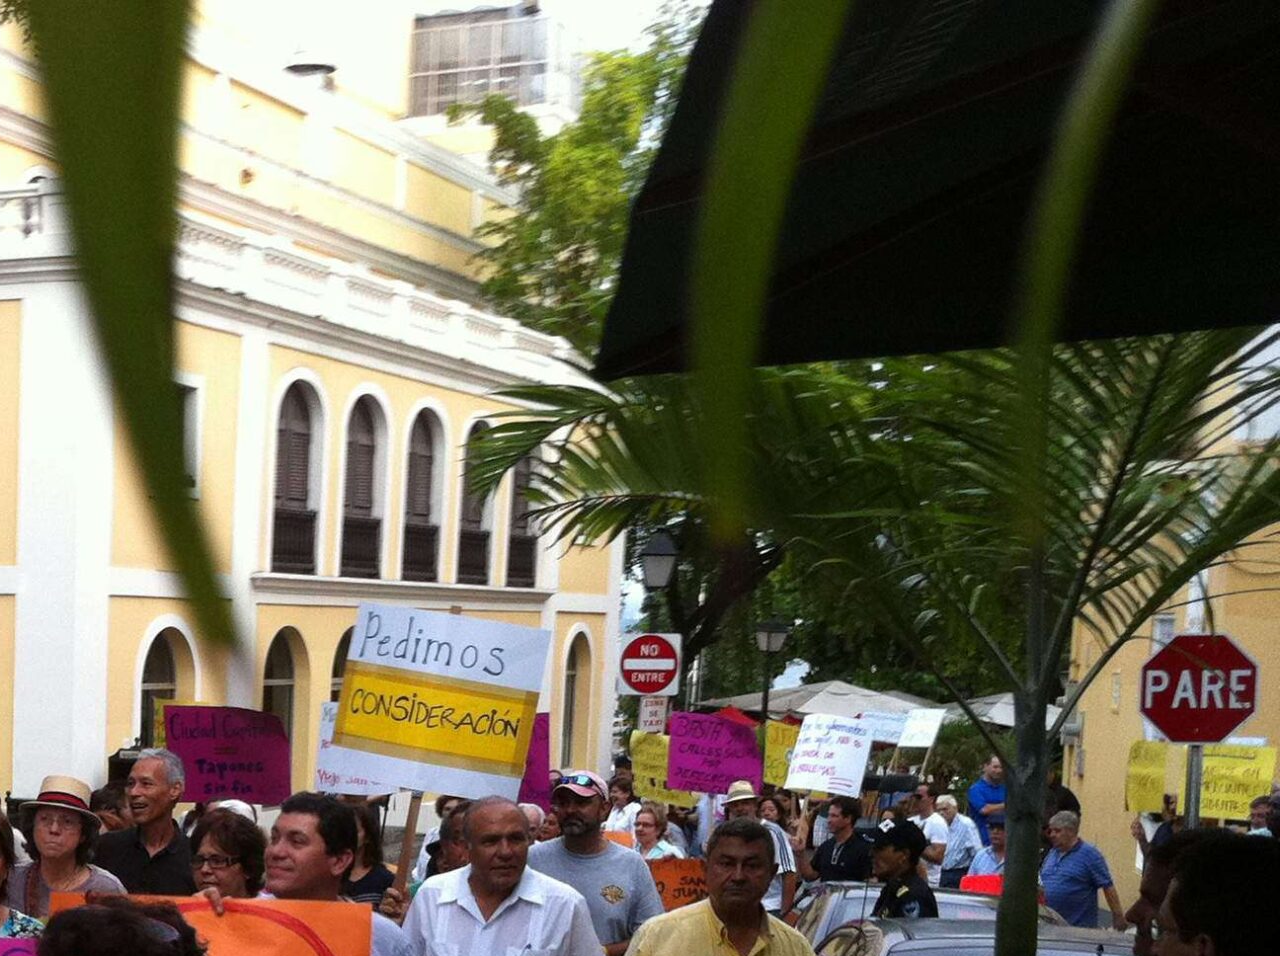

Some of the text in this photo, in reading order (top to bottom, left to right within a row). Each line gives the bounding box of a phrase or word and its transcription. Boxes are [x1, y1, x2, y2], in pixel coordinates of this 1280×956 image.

[359, 611, 505, 677] Pedimos
[639, 644, 661, 657] NO
[630, 672, 667, 684] ENTRE
[1144, 669, 1253, 710] PARE
[350, 688, 520, 739] CONSIDERACIÓN
